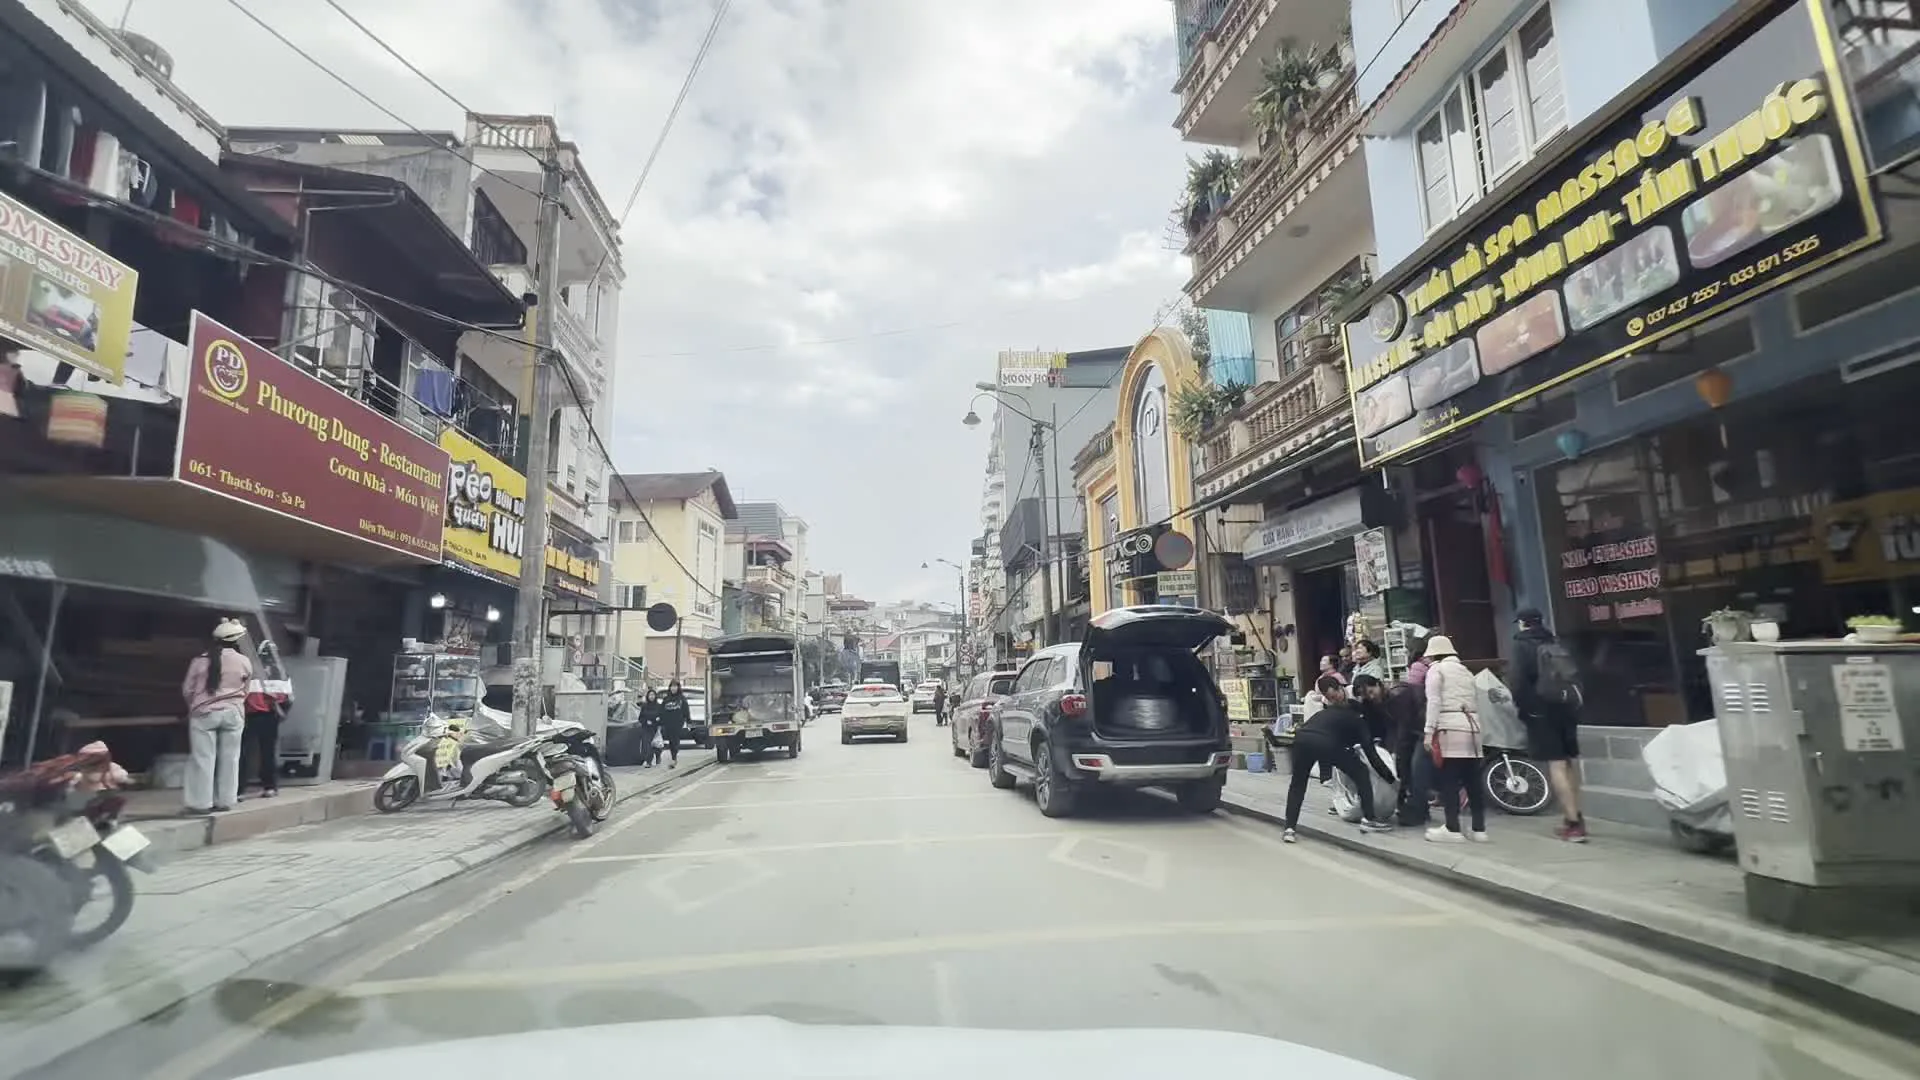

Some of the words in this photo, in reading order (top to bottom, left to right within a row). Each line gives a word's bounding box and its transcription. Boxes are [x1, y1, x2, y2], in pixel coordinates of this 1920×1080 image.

[1692, 78, 1827, 182] THUỐC
[1484, 214, 1537, 266] SPA
[1536, 96, 1704, 231] MASSAGE
[1646, 306, 1666, 325] 037
[1667, 296, 1688, 316] 437
[1692, 280, 1721, 305] 2557
[1729, 265, 1756, 286] 033
[1757, 254, 1780, 274] 871
[1782, 235, 1820, 262] 5325
[215, 346, 242, 369] PD
[1002, 373, 1032, 384] MOON
[257, 380, 329, 442] Phương
[331, 418, 370, 461] Dung
[380, 442, 443, 489] Restaurant
[219, 469, 253, 493] Thạch
[254, 482, 274, 499] Sơn
[281, 491, 293, 504] Sa
[293, 497, 306, 510] Pa
[329, 457, 360, 483] Cơm
[363, 470, 386, 494] Nhà
[395, 485, 418, 507] Món
[420, 494, 440, 517] Việt
[493, 512, 524, 558] HU
[1565, 577, 1598, 598] HEAD
[1599, 568, 1661, 594] WASHING
